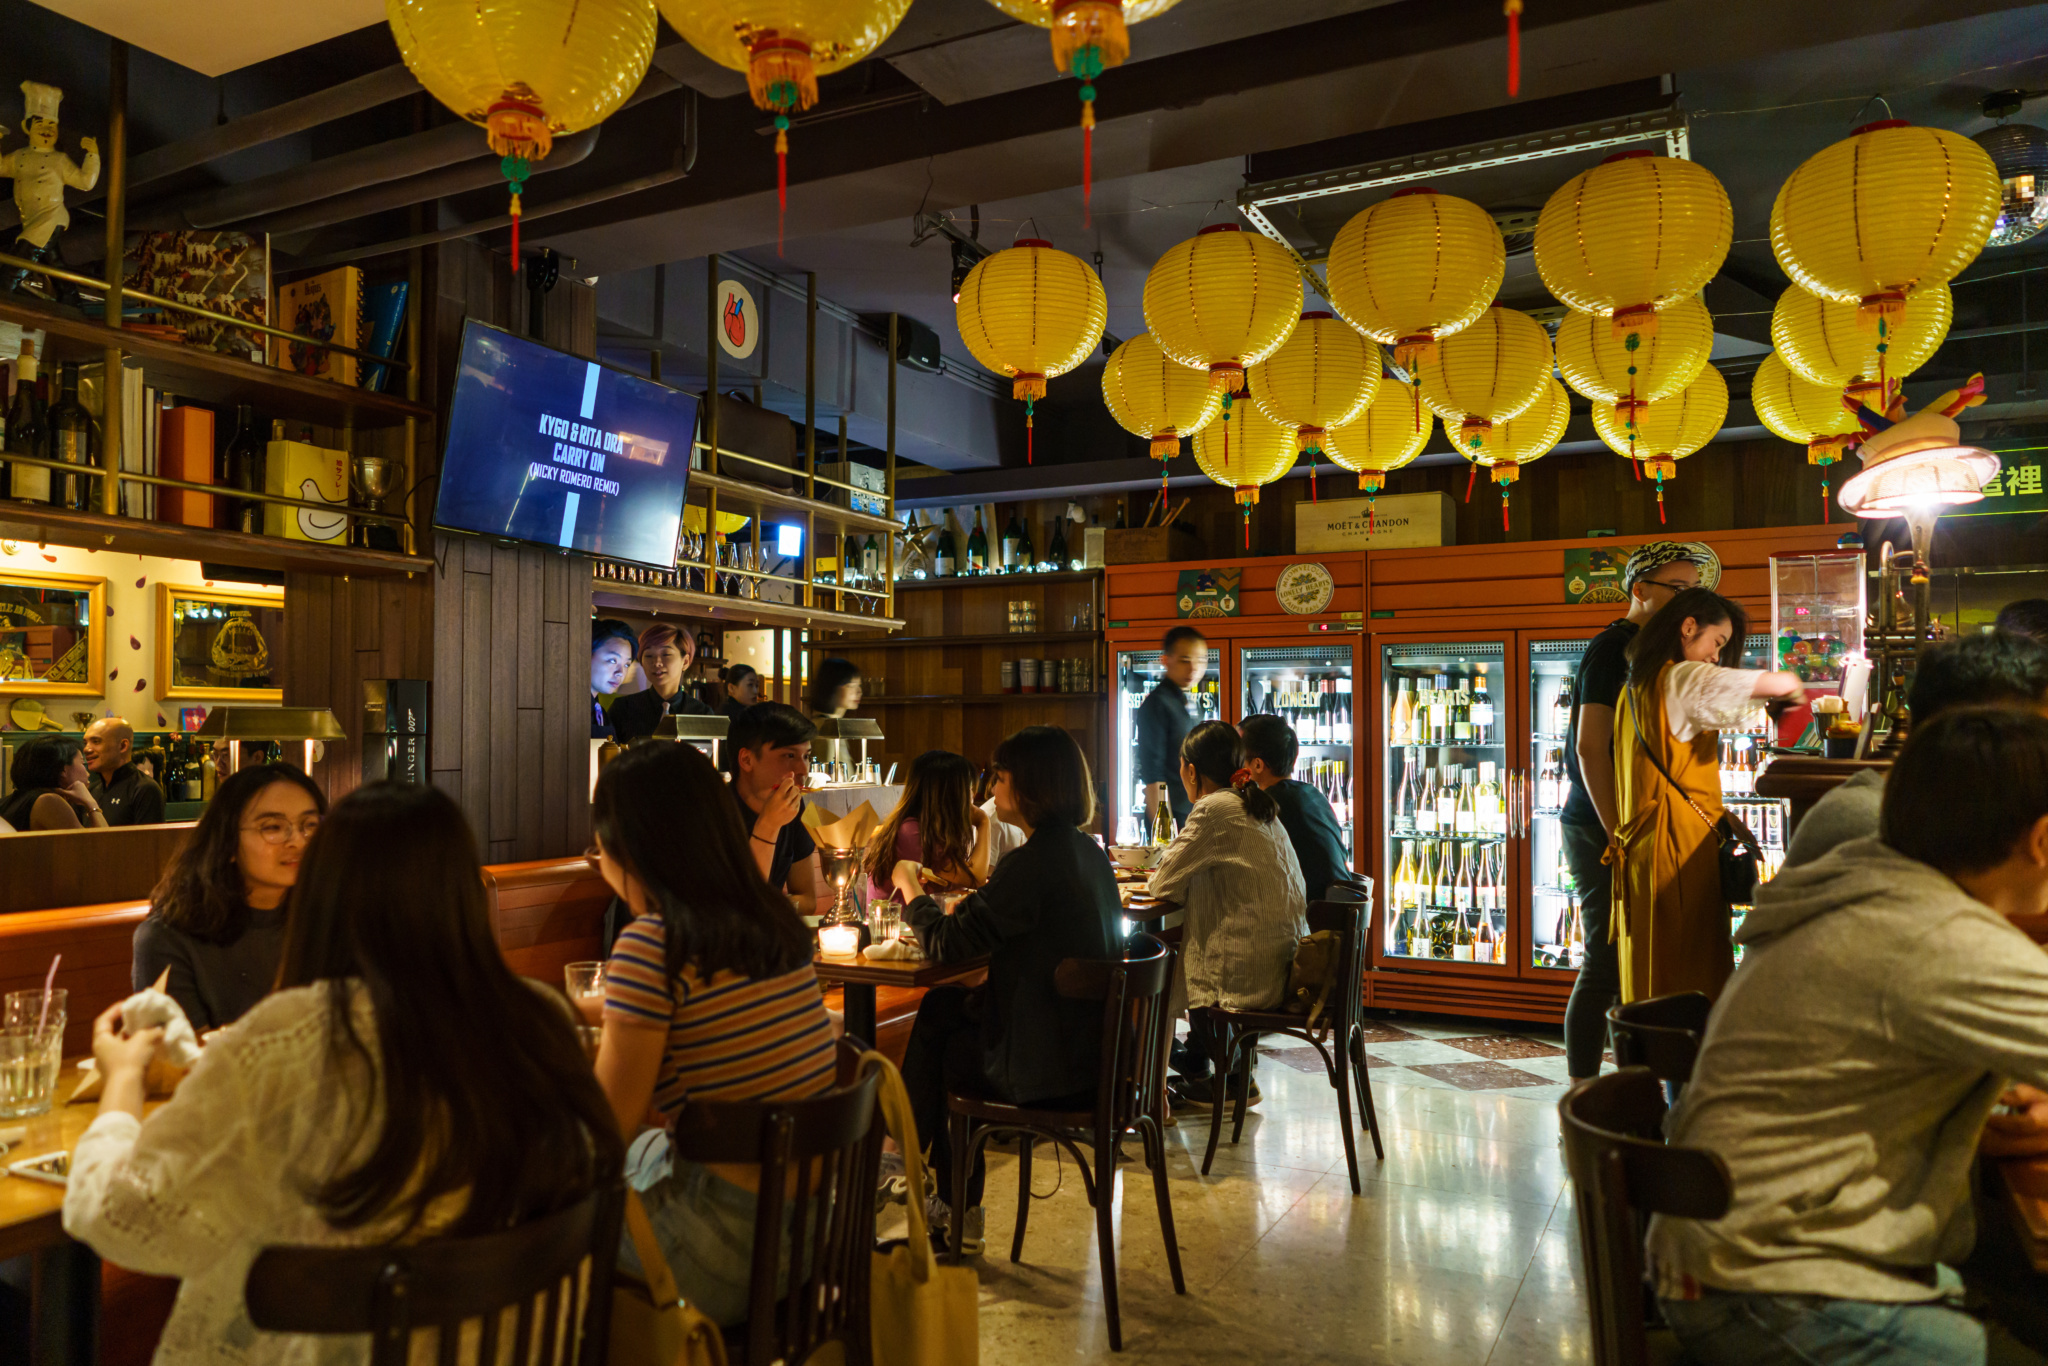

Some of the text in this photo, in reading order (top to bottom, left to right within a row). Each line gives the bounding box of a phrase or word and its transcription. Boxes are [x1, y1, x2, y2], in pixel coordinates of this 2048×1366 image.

[538, 413, 624, 455] KYGO & RITA ORA
[552, 442, 606, 473] CARRY ON
[529, 462, 620, 496] (NICKY ROMERO REMIX)
[1327, 521, 1353, 531] MOËT
[1362, 518, 1409, 528] CHANDON
[1280, 579, 1331, 599] LONELY HEARTS
[1285, 597, 1303, 613] TAIPEI
[1305, 604, 1319, 613] FAN
[1273, 691, 1322, 708] LONELY
[1419, 689, 1470, 706] HEARTS
[408, 708, 416, 732] 007
